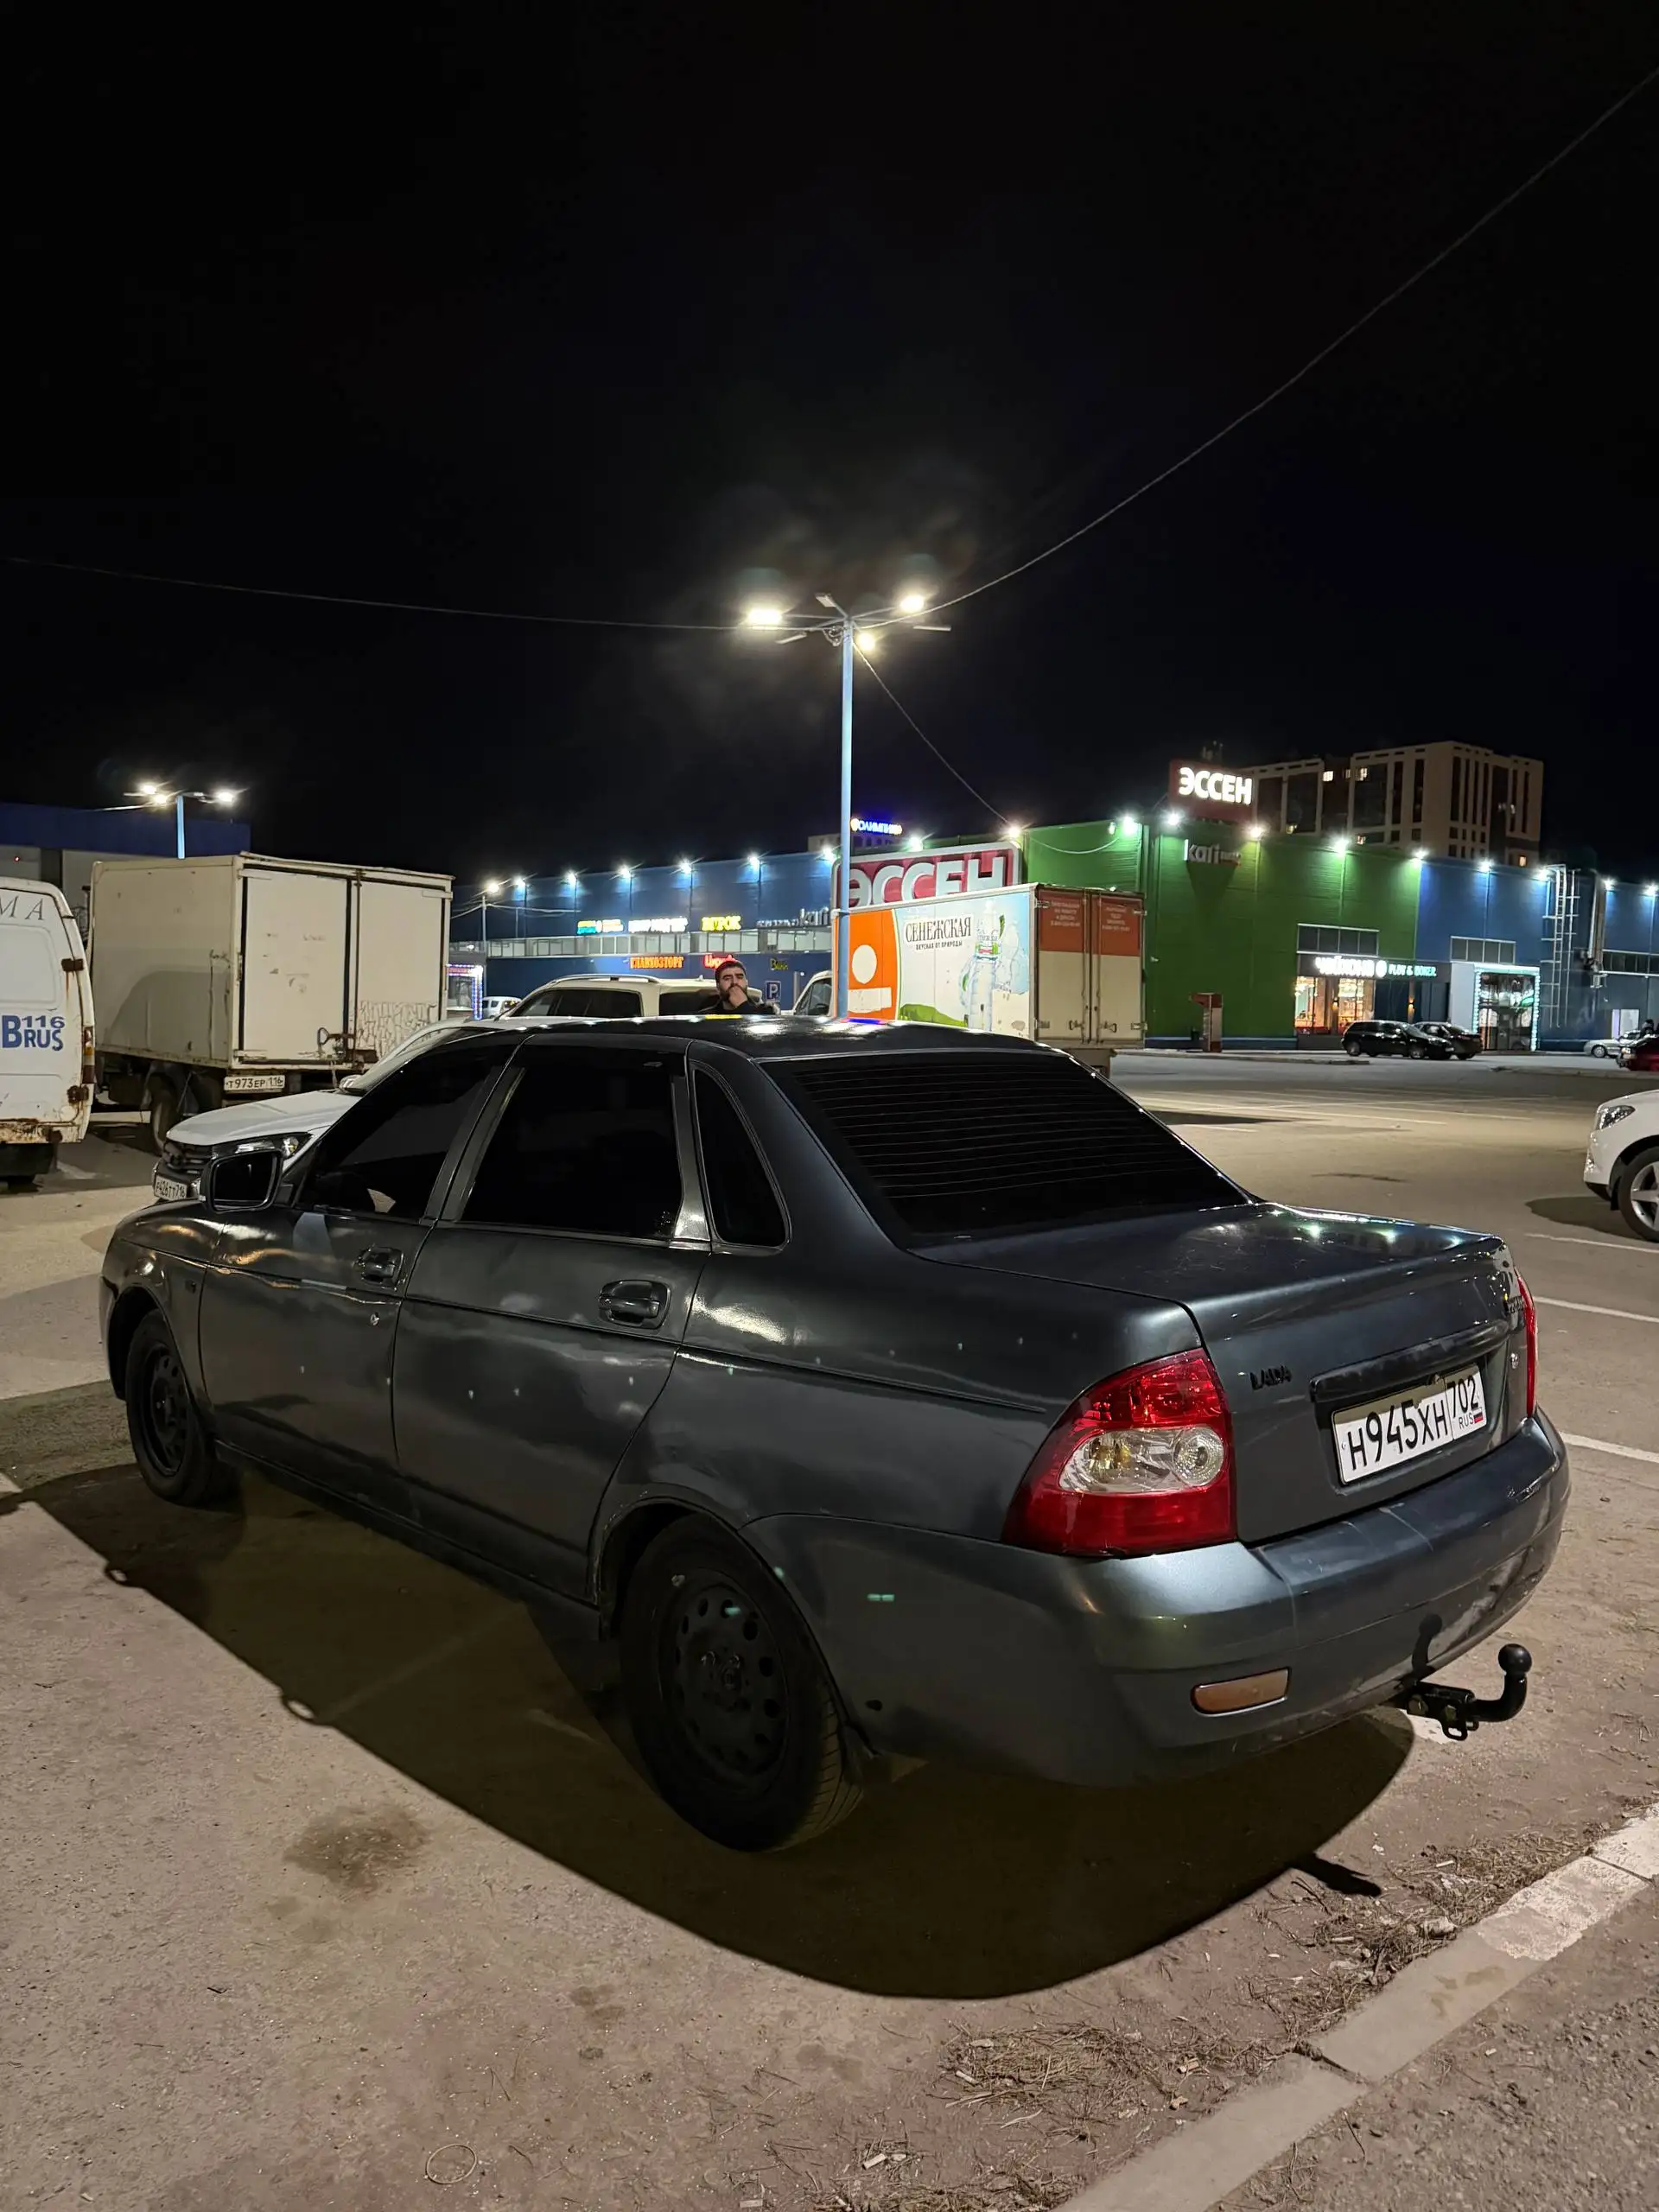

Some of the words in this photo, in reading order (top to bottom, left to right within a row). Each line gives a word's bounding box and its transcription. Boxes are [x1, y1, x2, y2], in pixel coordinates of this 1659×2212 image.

[1179, 766, 1253, 804] ЭССЕН
[1183, 839, 1220, 864] kari
[906, 917, 972, 943] СЕНЕЖСКАЯ
[941, 940, 963, 949] ПРИРОДЫ
[22, 1015, 66, 1029] 116
[24, 1029, 64, 1051] RUS
[1249, 1364, 1293, 1391] LADA
[1447, 1375, 1479, 1418] 702
[1458, 1412, 1475, 1430] RUS
